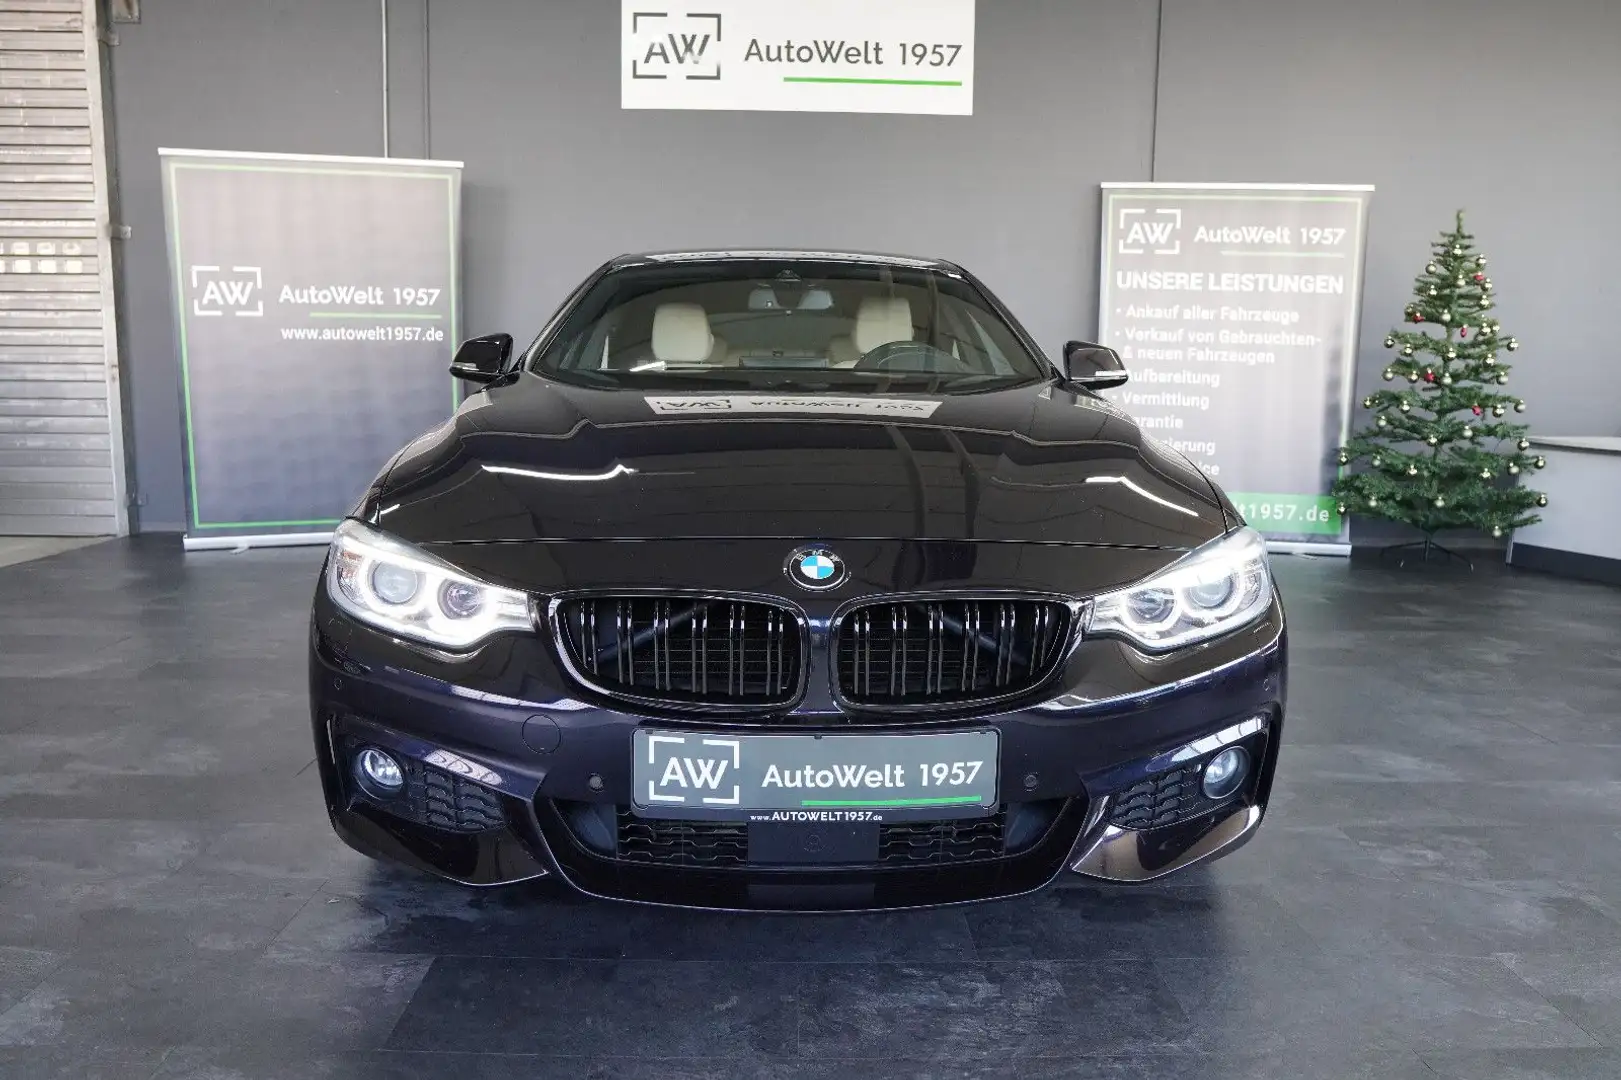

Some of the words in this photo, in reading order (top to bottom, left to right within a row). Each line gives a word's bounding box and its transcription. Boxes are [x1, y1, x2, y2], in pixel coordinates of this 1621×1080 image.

[643, 33, 711, 65] AW
[744, 38, 883, 65] AutoWelt
[899, 42, 962, 67] 1957
[1126, 221, 1174, 245] AW
[1194, 225, 1291, 245] AutoWelt
[1300, 227, 1346, 246] 1957
[201, 280, 254, 305] AW
[1116, 270, 1203, 291] UNSERE
[1208, 272, 1344, 294] LEISTUNGEN
[278, 284, 384, 306] AutoWelt
[393, 286, 441, 306] 1957
[1125, 304, 1180, 320] Ankauf
[1183, 305, 1216, 321] aller
[1220, 306, 1300, 326] Fahrzeuge
[280, 325, 444, 342] www.autowelt1957.de
[1125, 327, 1184, 343] Verkauf
[1188, 331, 1215, 343] von
[1138, 348, 1183, 361] neuen
[1187, 349, 1276, 366] Fahrzeugen
[1122, 391, 1210, 411] Vermittlung
[659, 756, 729, 790] AW
[761, 763, 906, 789] AutoWelt
[919, 760, 983, 787] 1957
